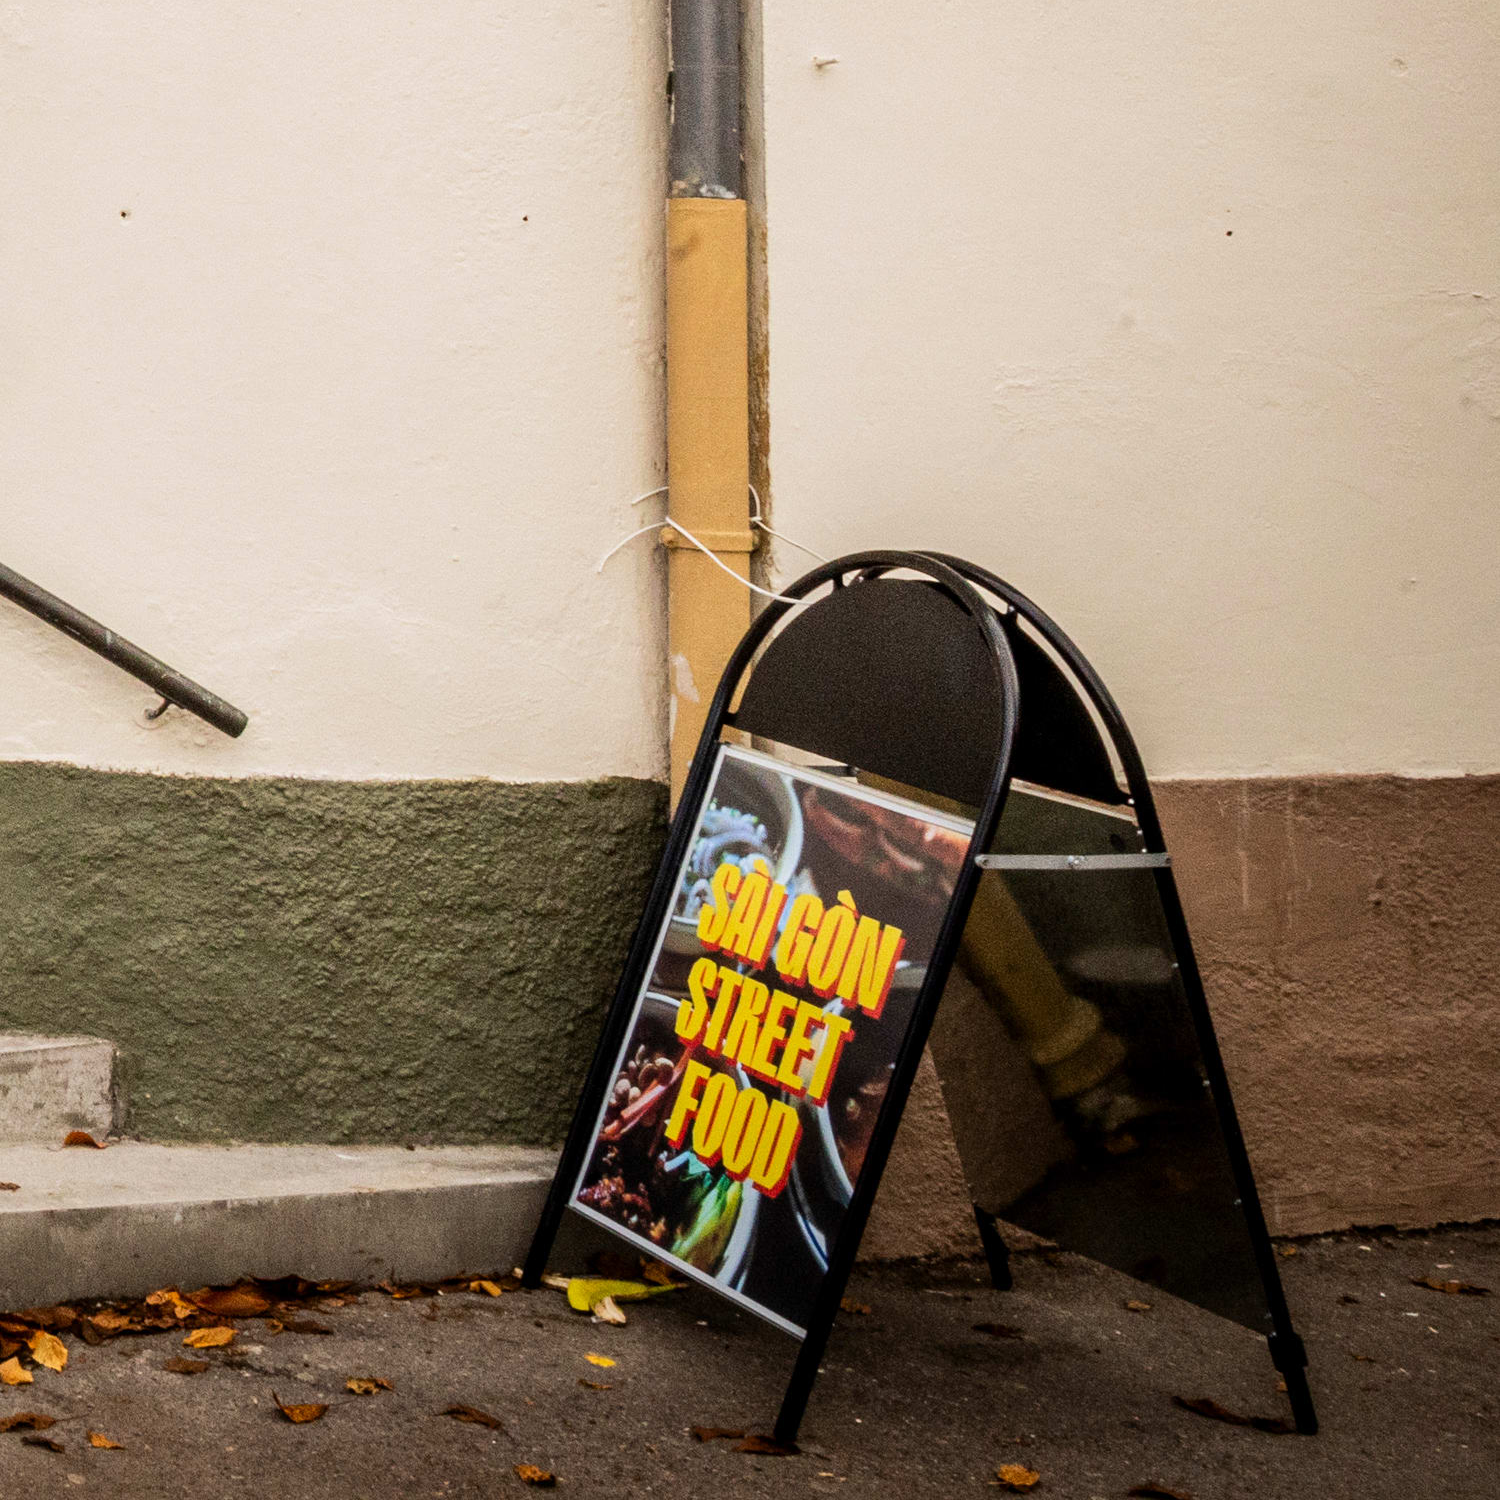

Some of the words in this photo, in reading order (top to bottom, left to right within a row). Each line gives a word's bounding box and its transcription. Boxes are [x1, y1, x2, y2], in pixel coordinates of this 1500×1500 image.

[697, 858, 788, 966] SÀI
[775, 889, 904, 1015] GÒN
[675, 957, 853, 1105] STREET
[665, 1060, 801, 1195] FOOD
